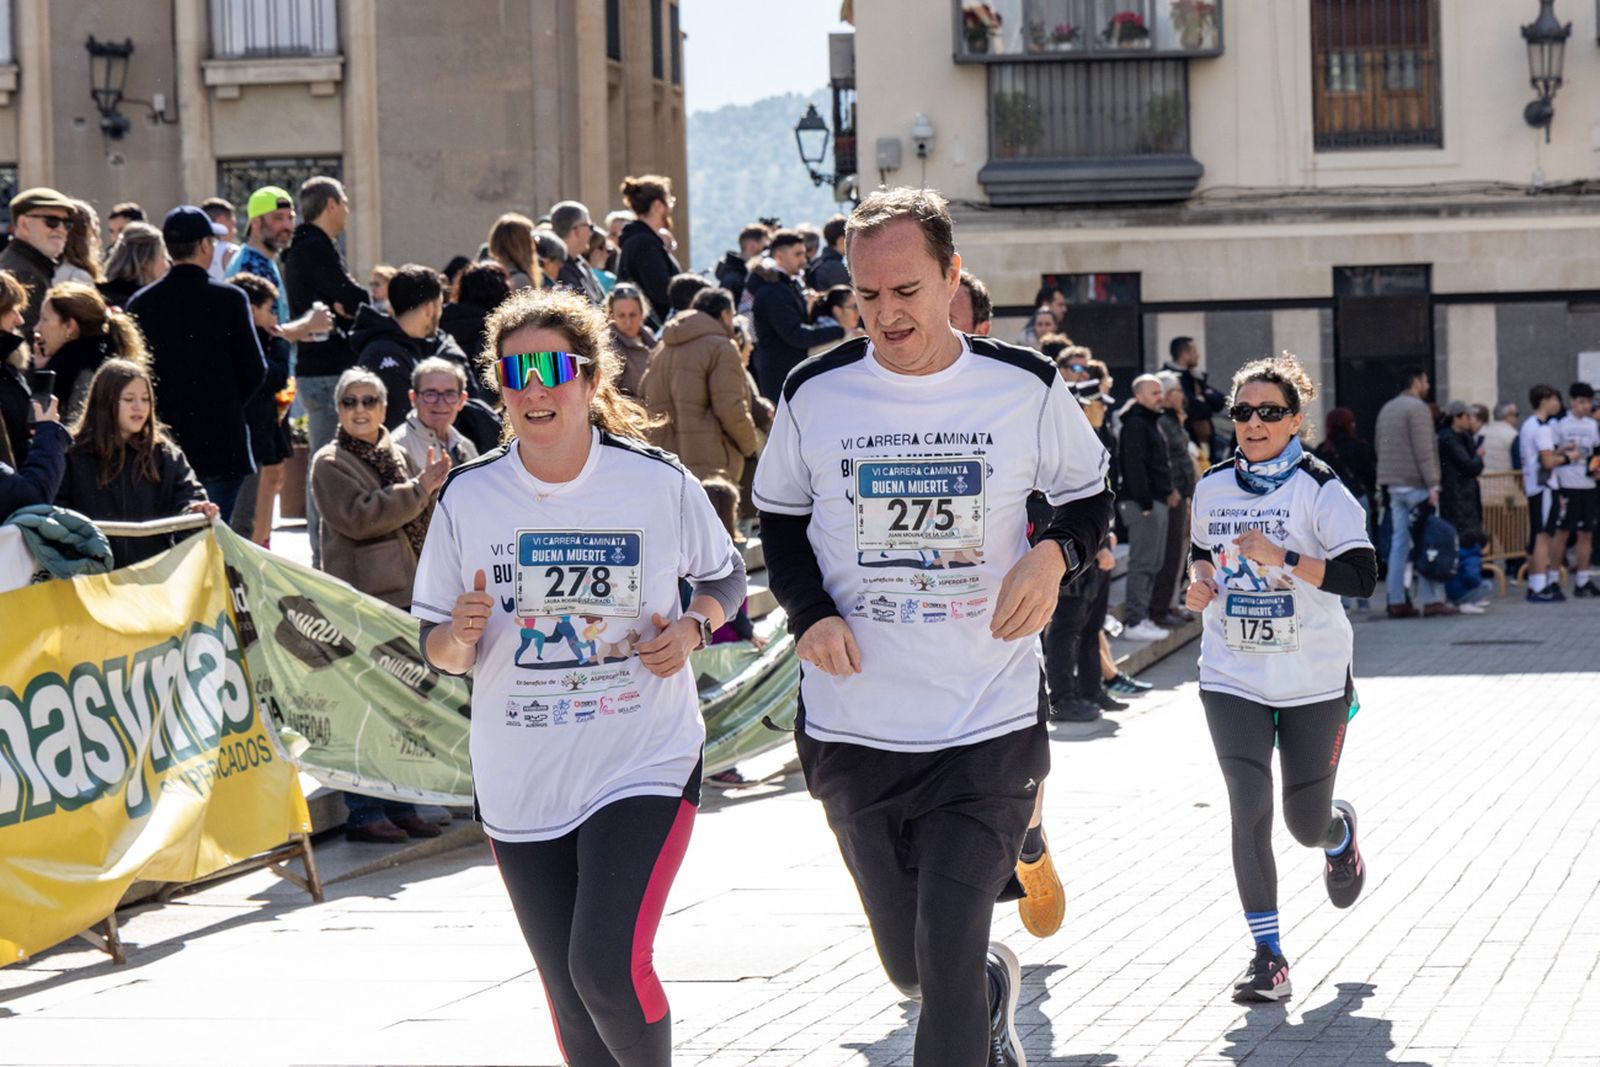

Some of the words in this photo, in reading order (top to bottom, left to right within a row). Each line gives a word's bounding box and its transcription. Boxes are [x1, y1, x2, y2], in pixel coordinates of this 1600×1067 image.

[841, 438, 853, 450] VI
[856, 433, 920, 449] CARRERA
[924, 432, 994, 445] CAMINATA
[872, 467, 881, 476] VI
[882, 466, 922, 476] CARRERA
[923, 465, 968, 476] CAMINATA
[872, 480, 905, 494] BUENA
[908, 479, 949, 493] MUERTE
[887, 498, 955, 531] 275
[1216, 508, 1247, 517] CARRERA
[1250, 508, 1290, 518] CAMINATA
[1208, 522, 1231, 535] BUENA
[532, 538, 541, 546] VI
[543, 537, 581, 546] CARRERA
[582, 537, 627, 546] CAMINATA
[491, 545, 504, 556] VI
[531, 549, 564, 562] BUENA
[566, 549, 607, 562] MUERTE
[545, 566, 611, 598] 278
[1240, 619, 1274, 640] 175
